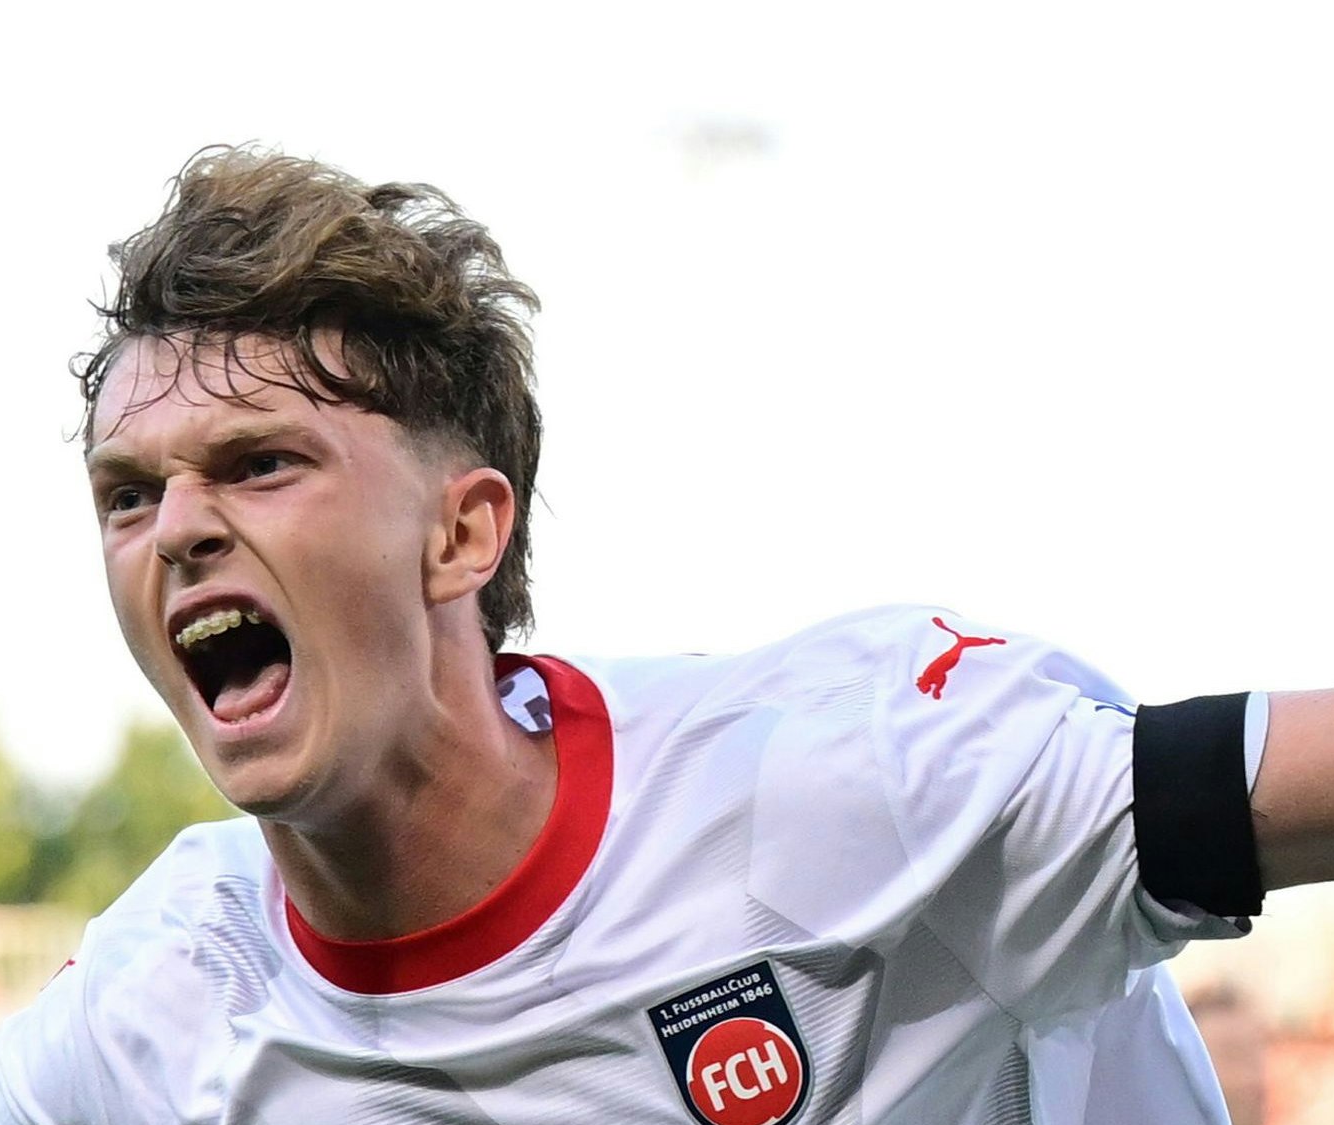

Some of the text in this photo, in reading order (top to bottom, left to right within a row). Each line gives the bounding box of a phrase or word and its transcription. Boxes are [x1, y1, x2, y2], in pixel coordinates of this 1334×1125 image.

[661, 983, 773, 1038] HEIDENHEIM 1846
[701, 1040, 788, 1112] FCH
